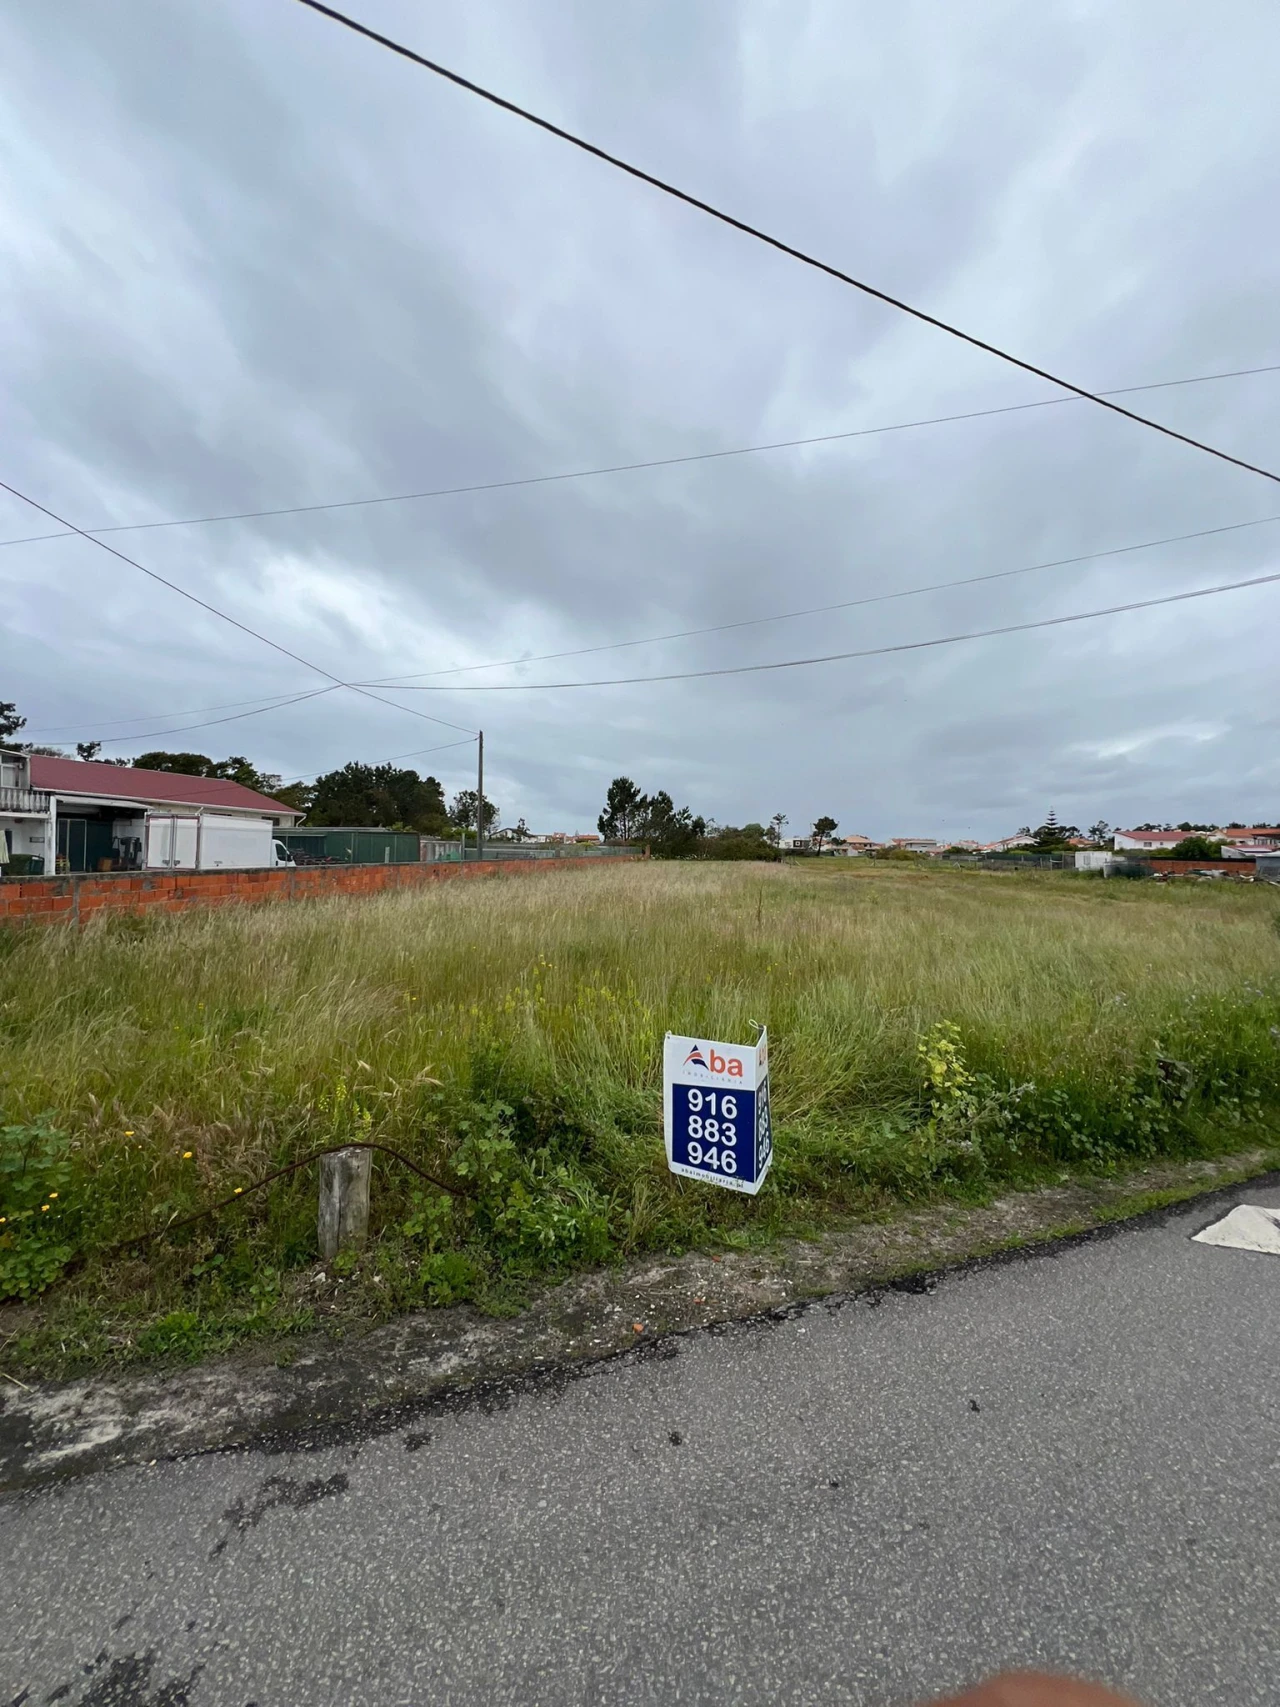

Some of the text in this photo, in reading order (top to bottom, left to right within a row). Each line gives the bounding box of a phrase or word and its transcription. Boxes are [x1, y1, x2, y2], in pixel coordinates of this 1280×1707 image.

[687, 1088, 737, 1119] 916
[688, 1115, 737, 1147] 883
[687, 1141, 737, 1174] 946
